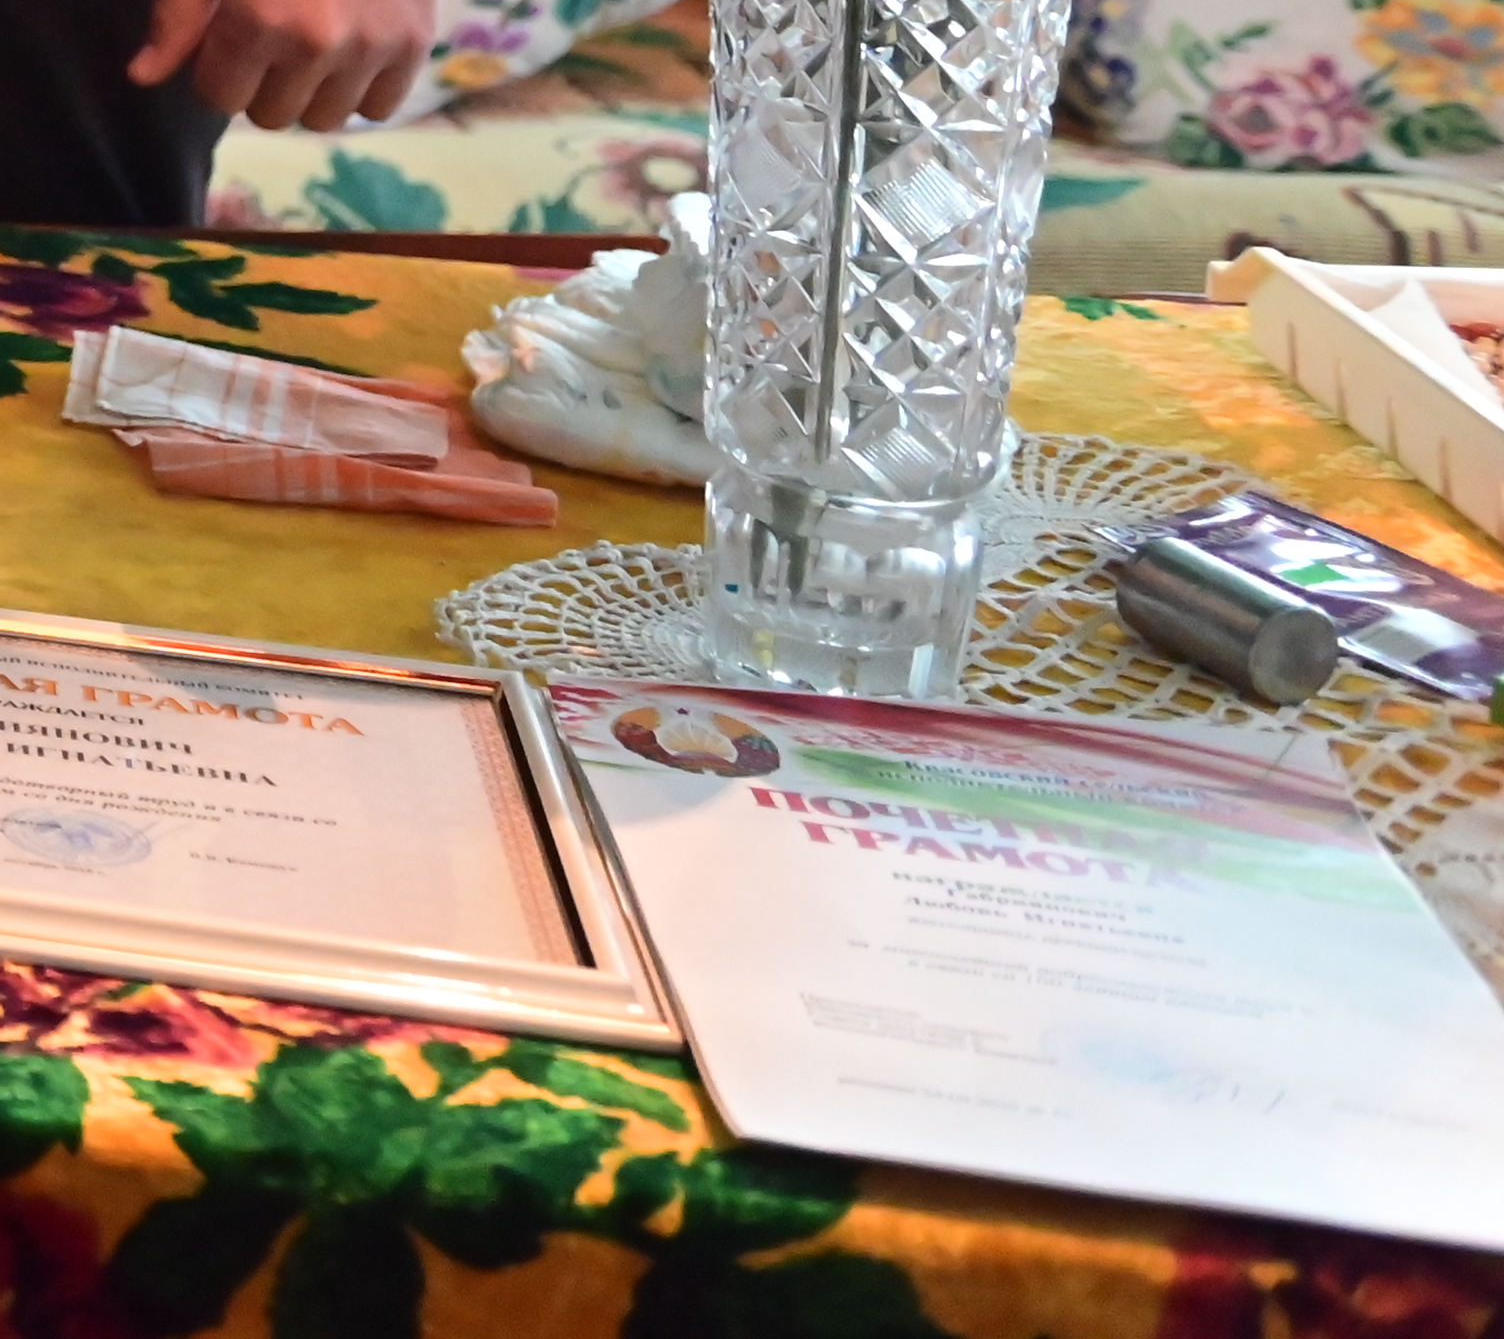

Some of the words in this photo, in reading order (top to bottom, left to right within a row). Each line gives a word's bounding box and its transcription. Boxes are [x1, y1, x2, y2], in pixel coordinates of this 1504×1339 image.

[82, 684, 366, 736] ГРАМОТА
[6, 742, 278, 787] ИГНАТЬЕВНА
[800, 820, 1206, 894] ГРАМОТА
